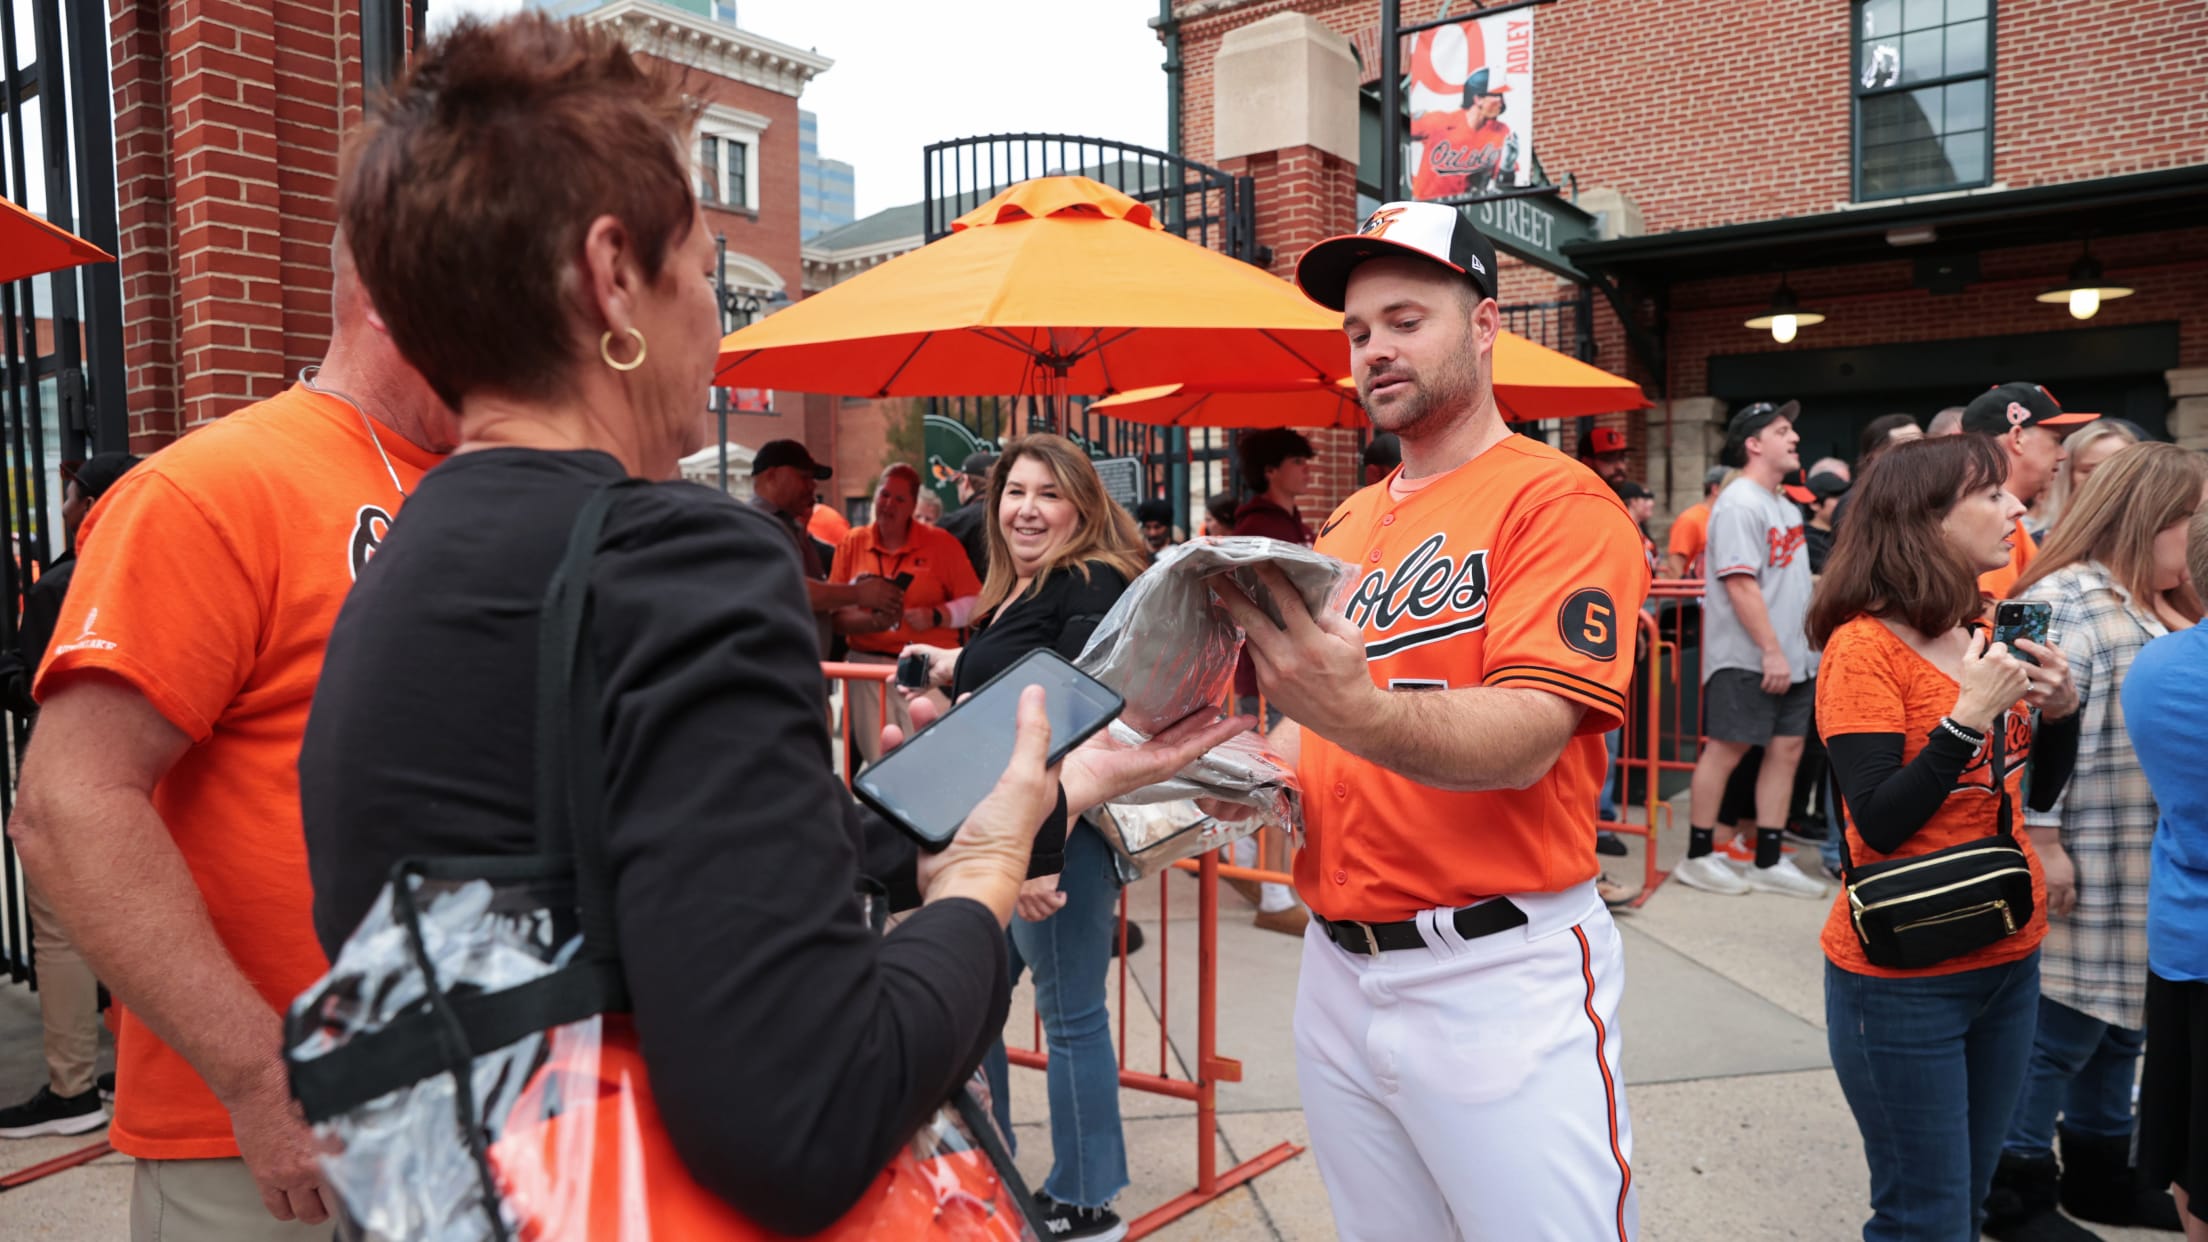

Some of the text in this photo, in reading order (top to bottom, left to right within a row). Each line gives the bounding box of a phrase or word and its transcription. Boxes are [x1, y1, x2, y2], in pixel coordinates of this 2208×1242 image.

[1506, 20, 1531, 75] ADLEY
[1479, 198, 1555, 252] STREET
[1583, 602, 1611, 645] 5
